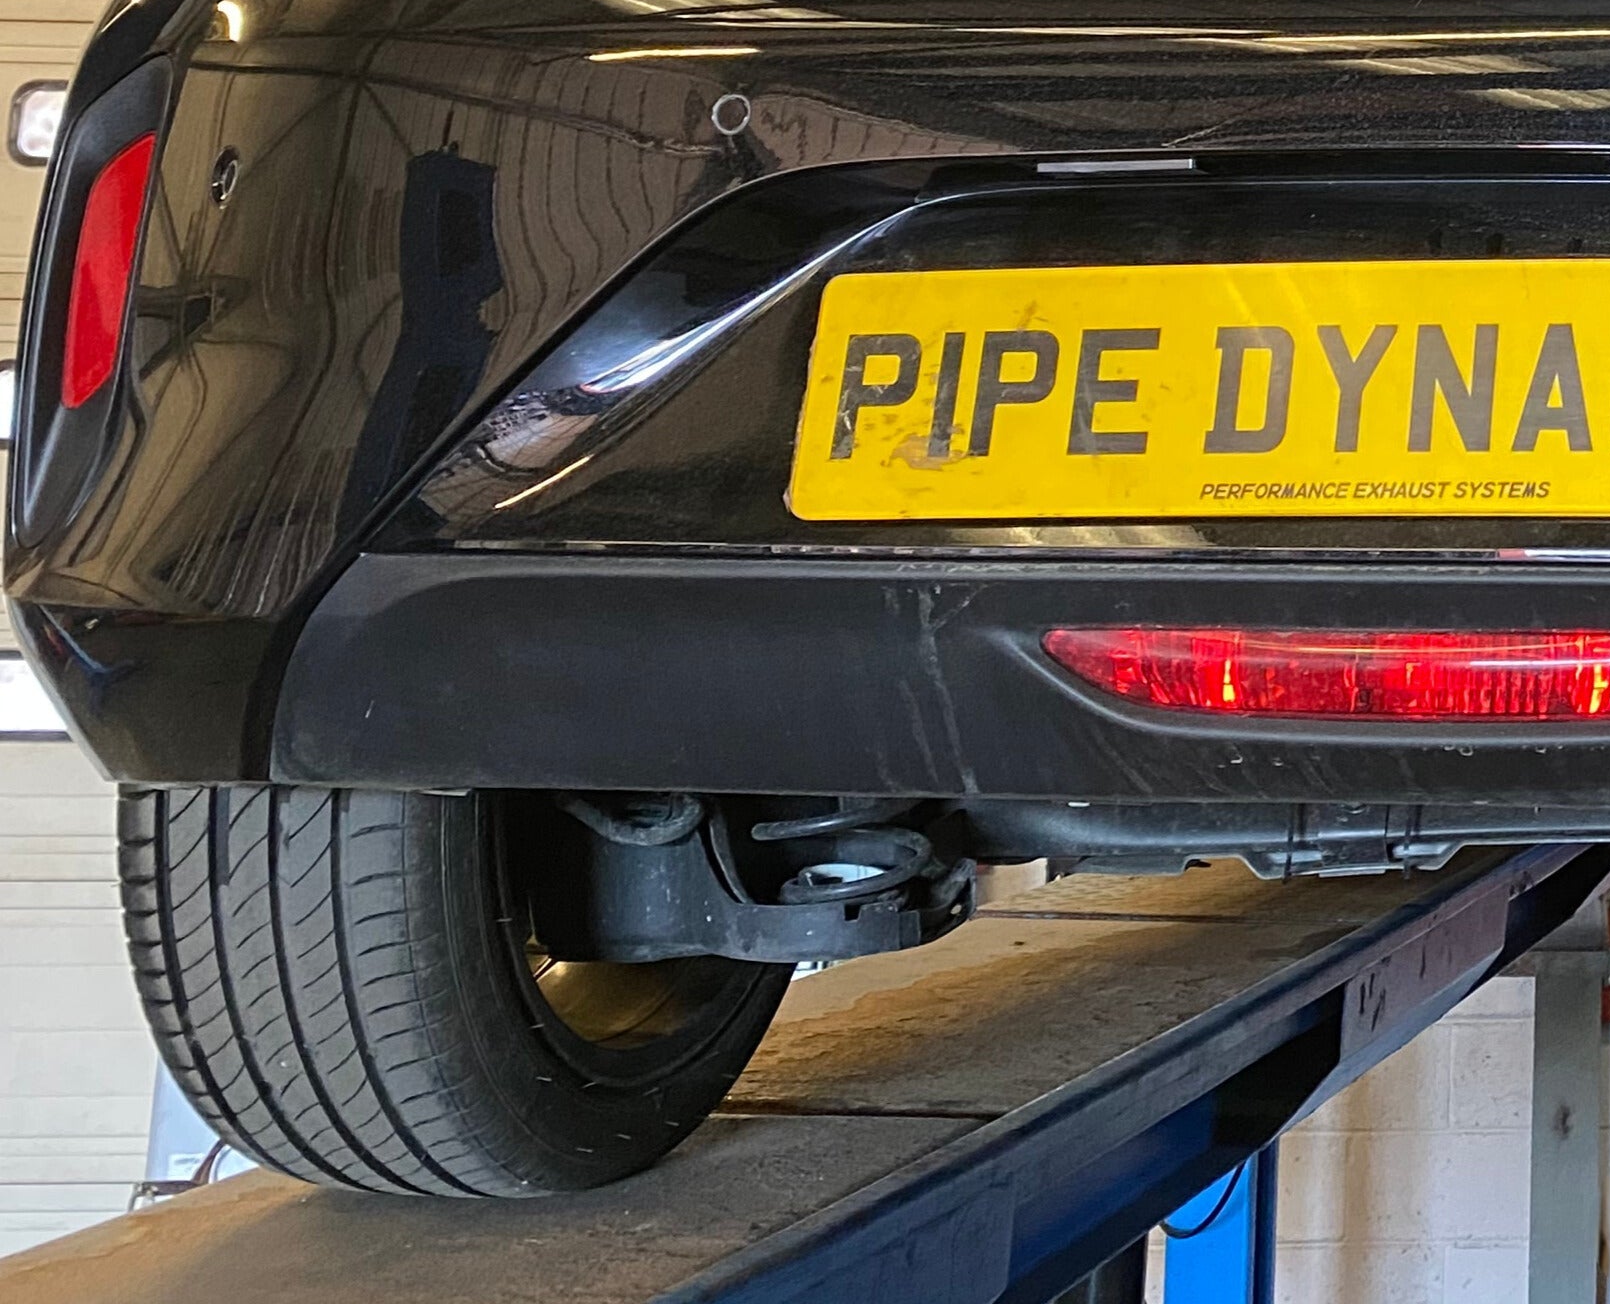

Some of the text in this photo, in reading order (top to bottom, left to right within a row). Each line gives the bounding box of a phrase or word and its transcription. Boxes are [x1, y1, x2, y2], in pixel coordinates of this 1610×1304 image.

[829, 327, 1161, 460] PIPE
[1200, 481, 1551, 500] PERFORMANCE EXHAUST SYSTEMS
